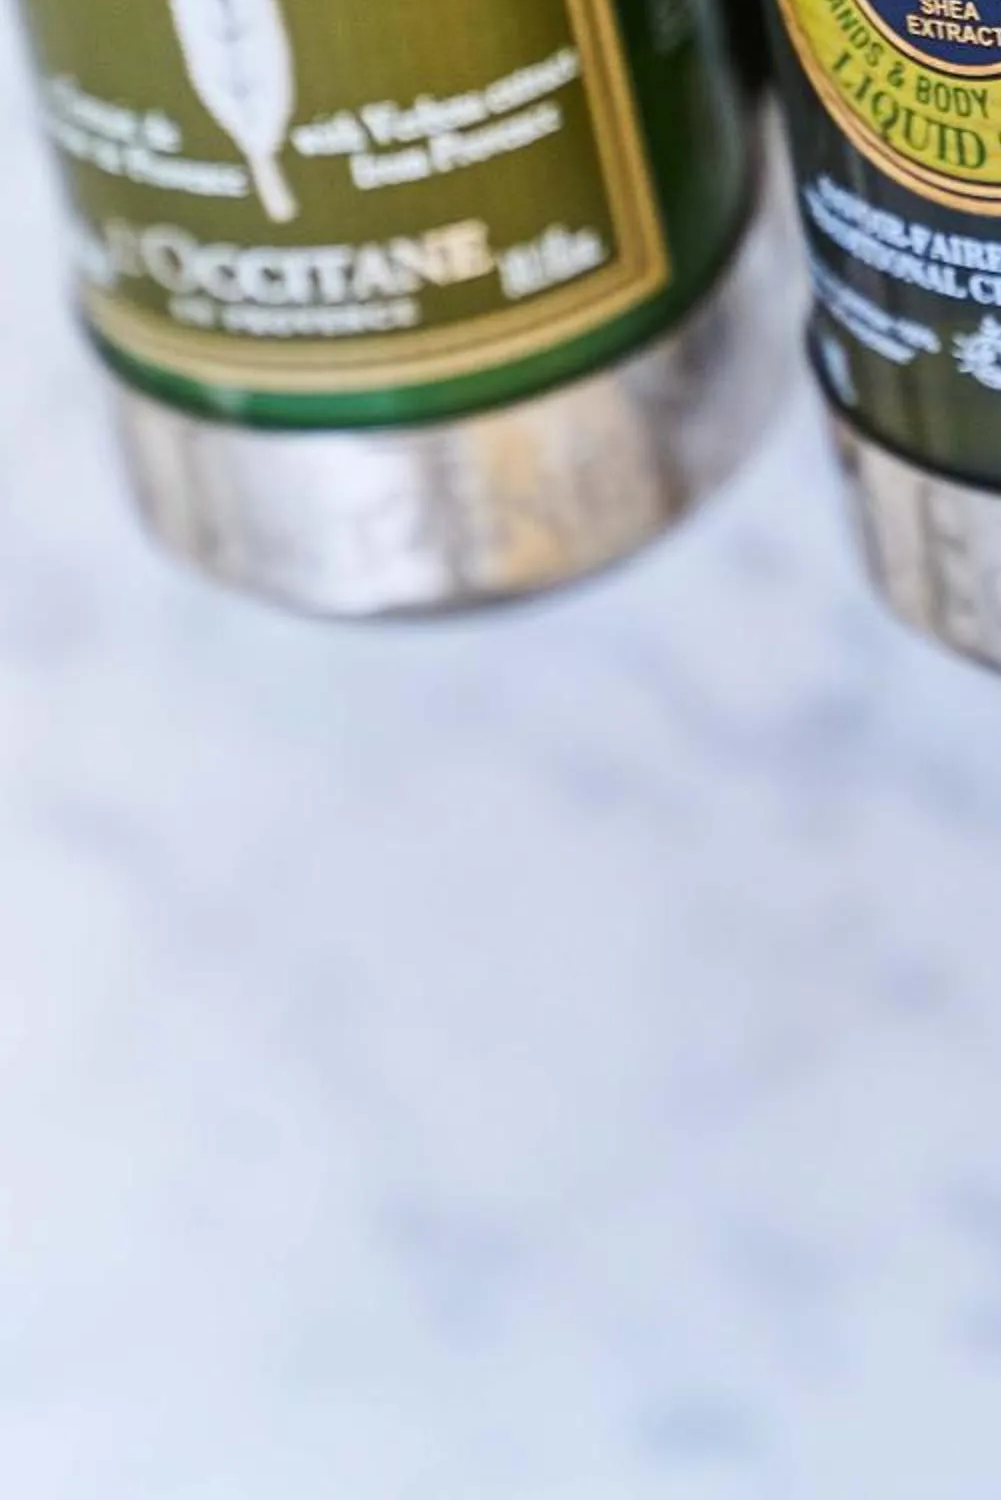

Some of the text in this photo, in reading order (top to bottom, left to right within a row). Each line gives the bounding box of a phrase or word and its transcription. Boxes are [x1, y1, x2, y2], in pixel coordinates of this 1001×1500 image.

[828, 49, 989, 171] LIQUID
[883, 58, 906, 89] &
[915, 78, 991, 120] BODY
